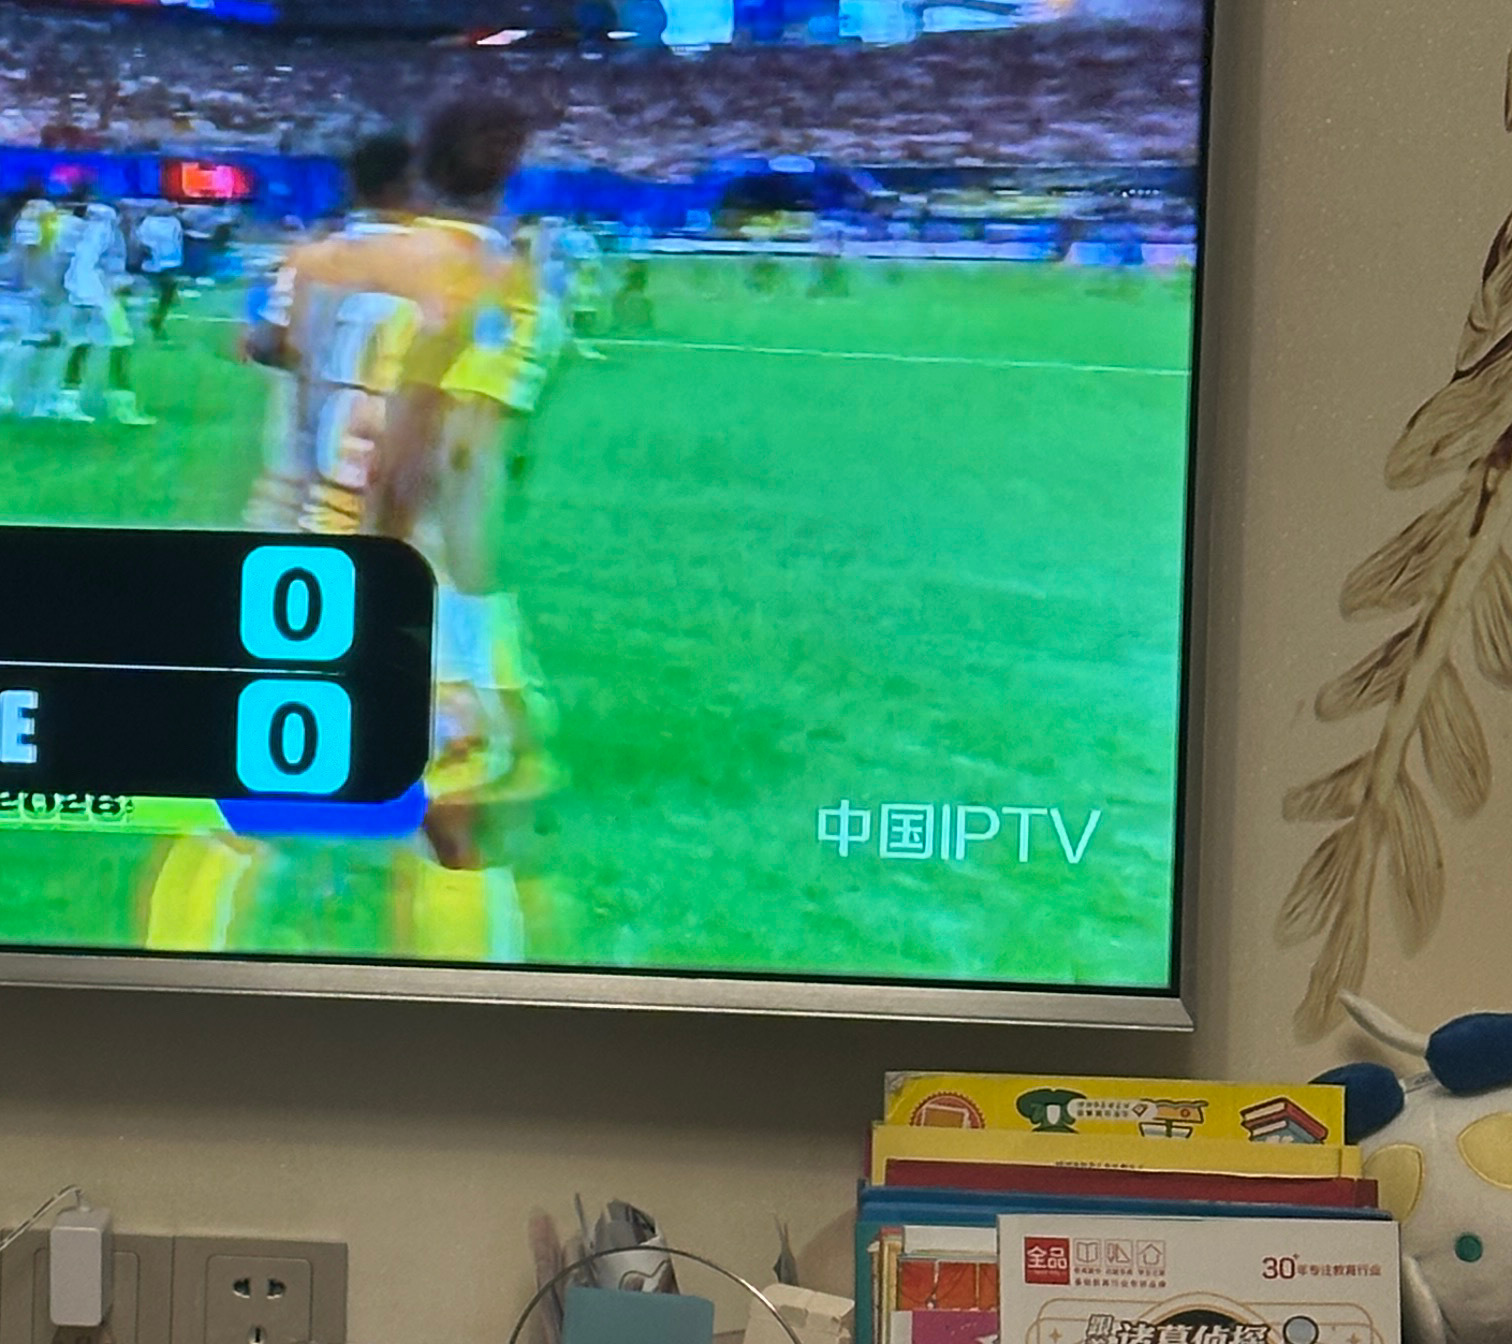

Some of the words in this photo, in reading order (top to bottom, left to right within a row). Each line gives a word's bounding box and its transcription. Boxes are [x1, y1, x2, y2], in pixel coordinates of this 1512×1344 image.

[273, 568, 323, 642] 0
[269, 701, 318, 774] 0
[817, 799, 1102, 864] 中国IPTV
[1026, 1245, 1069, 1270] 全品
